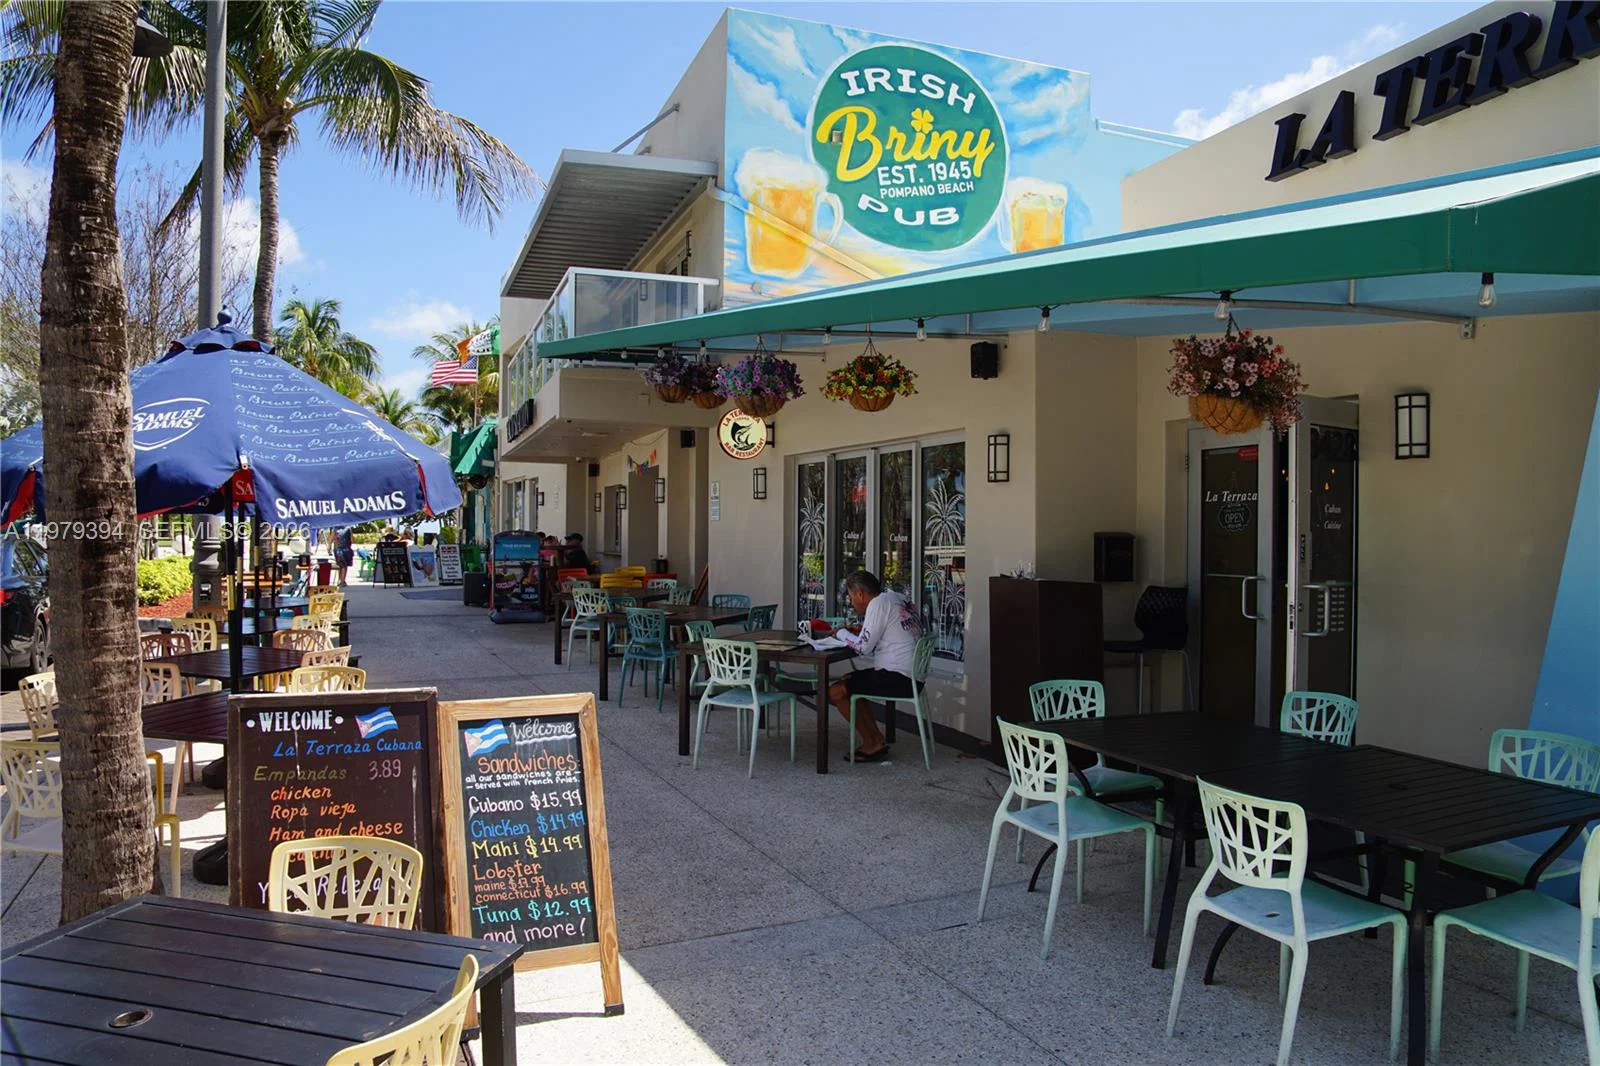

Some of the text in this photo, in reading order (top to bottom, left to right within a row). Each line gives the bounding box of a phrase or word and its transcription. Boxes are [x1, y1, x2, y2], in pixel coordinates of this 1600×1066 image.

[840, 67, 976, 113] IRISH
[816, 106, 995, 182] Briny
[1265, 90, 1357, 182] LA
[877, 161, 971, 186] EST. 1945
[880, 181, 974, 199] POMPANO BEACH
[857, 194, 959, 225] PUB
[231, 368, 284, 380] Brewer
[249, 395, 302, 407] Brewer
[133, 407, 206, 424] SAMUEL
[235, 405, 285, 420] Brewer
[133, 418, 195, 432] ADAMS
[265, 424, 320, 437] Brewer
[252, 435, 304, 449] Brewer
[308, 436, 361, 449] Patriot
[735, 438, 764, 457] RESTAURANT
[284, 453, 340, 465] Brewer
[345, 448, 398, 461] Patriot
[276, 491, 406, 519] SAMUEL ADAMS
[1205, 491, 1258, 502] La Terraza
[1225, 513, 1245, 524] OPEN
[259, 709, 333, 732] WELCOME
[510, 718, 575, 739] Welcome
[272, 738, 423, 757] La Terraza Cubana
[369, 758, 401, 780] 3.89
[478, 749, 577, 774] Sandwiches
[465, 774, 476, 783] all
[496, 770, 552, 781] sandwiches
[475, 782, 502, 790] served
[503, 779, 520, 787] with
[270, 786, 332, 800] chicken
[469, 789, 582, 818] Cubano $15.99
[270, 804, 309, 823] Ropa
[269, 821, 404, 841] Ham and cheese
[471, 819, 530, 838] Chicken
[472, 835, 582, 859] Mahi $14.99
[472, 860, 542, 880] Lobster
[474, 882, 506, 892] maine
[472, 896, 592, 924] Tuna $12.99
[483, 917, 586, 944] and more!
